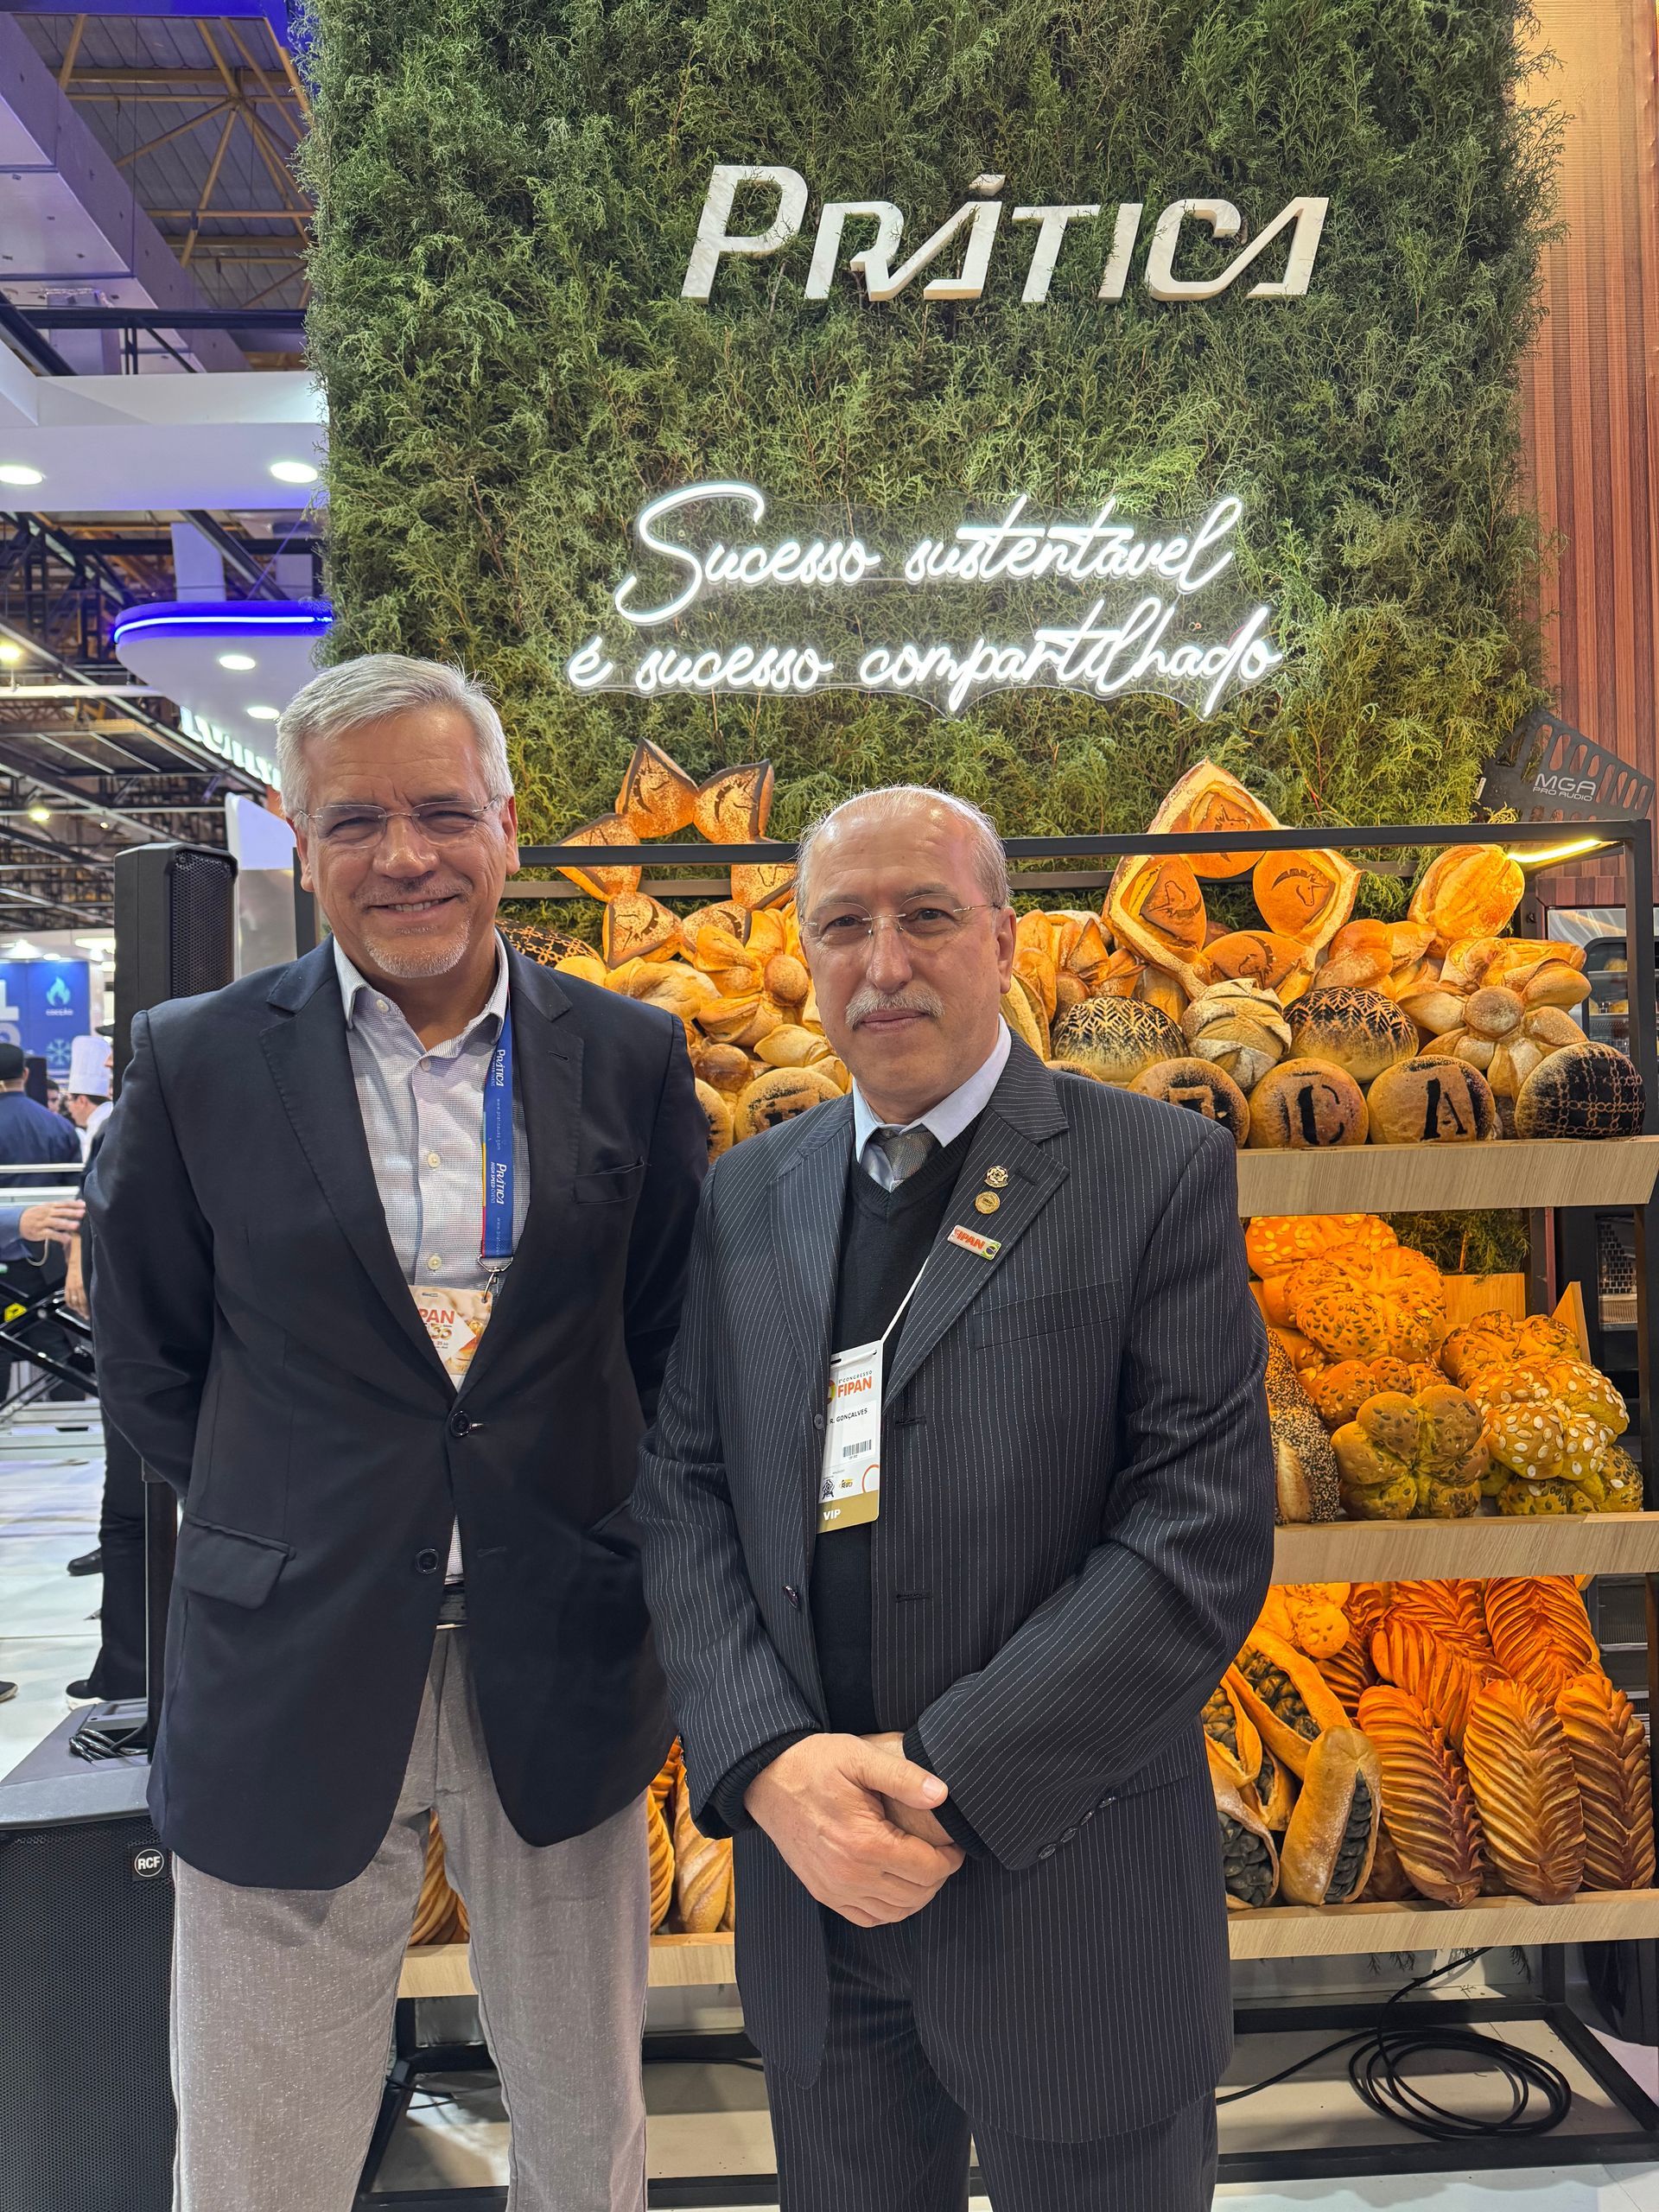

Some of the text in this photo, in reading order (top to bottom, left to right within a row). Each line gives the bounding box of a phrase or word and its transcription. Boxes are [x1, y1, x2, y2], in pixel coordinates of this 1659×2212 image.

[681, 165, 1329, 304] PRÁTICA
[614, 481, 1243, 624] Sucesso sustentável
[568, 597, 1282, 717] é sucesso compartilhado
[1532, 786, 1593, 802] PRO AUDIO
[1534, 773, 1596, 796] MGA
[496, 1162, 507, 1205] PRÁTICA
[954, 1230, 985, 1249] FIPAN
[837, 1376, 873, 1398] FIPAN
[836, 1408, 868, 1421] GONÇALVES
[823, 1509, 842, 1521] VIP
[138, 1856, 160, 1870] RCF
